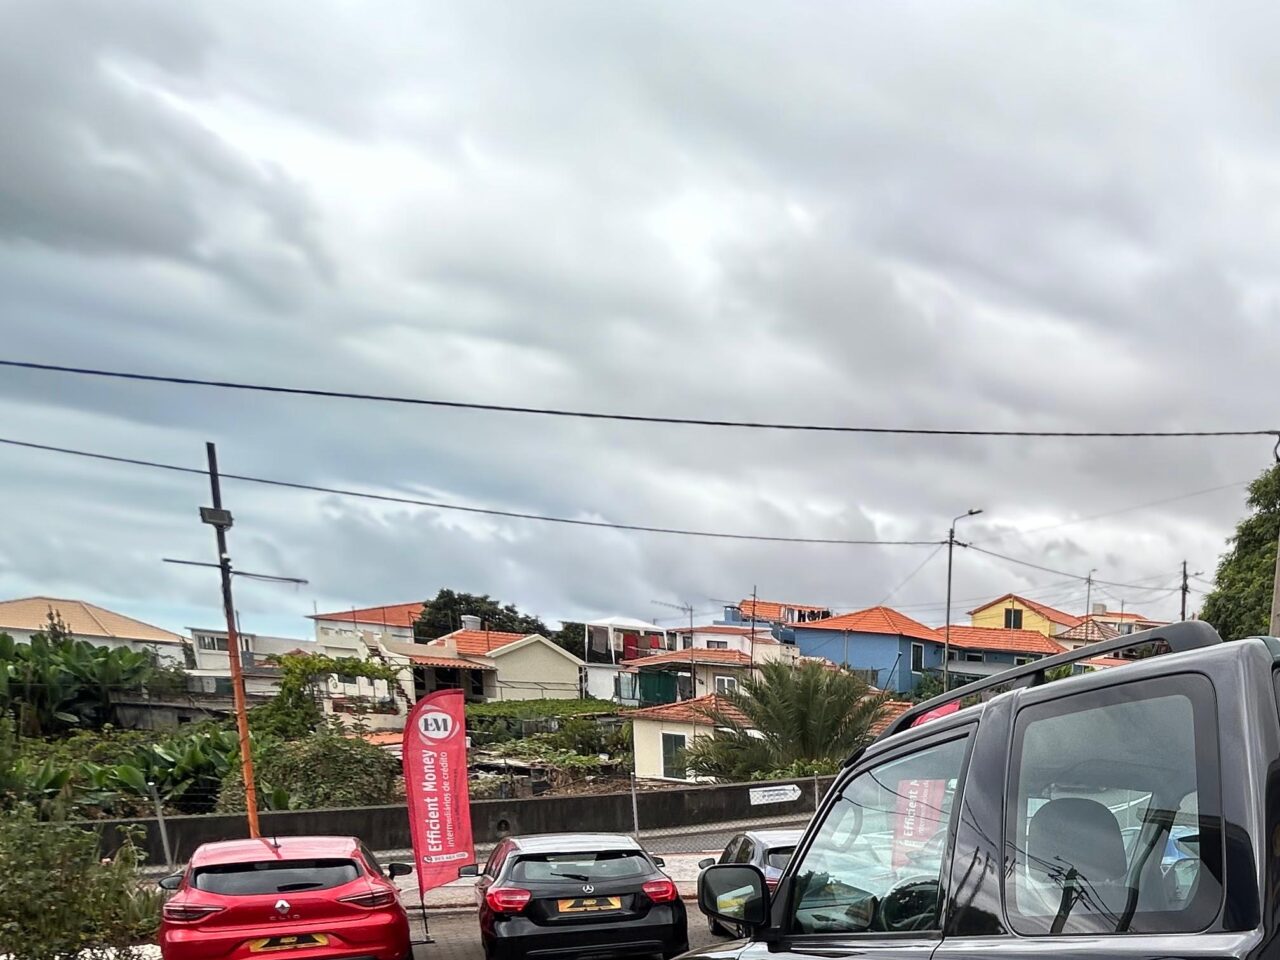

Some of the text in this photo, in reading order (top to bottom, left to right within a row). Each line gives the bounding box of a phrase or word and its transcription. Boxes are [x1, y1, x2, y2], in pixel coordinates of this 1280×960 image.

[423, 718, 449, 732] EM
[439, 751, 449, 780] crédito
[442, 780, 451, 791] de
[421, 749, 443, 852] Efficient Money
